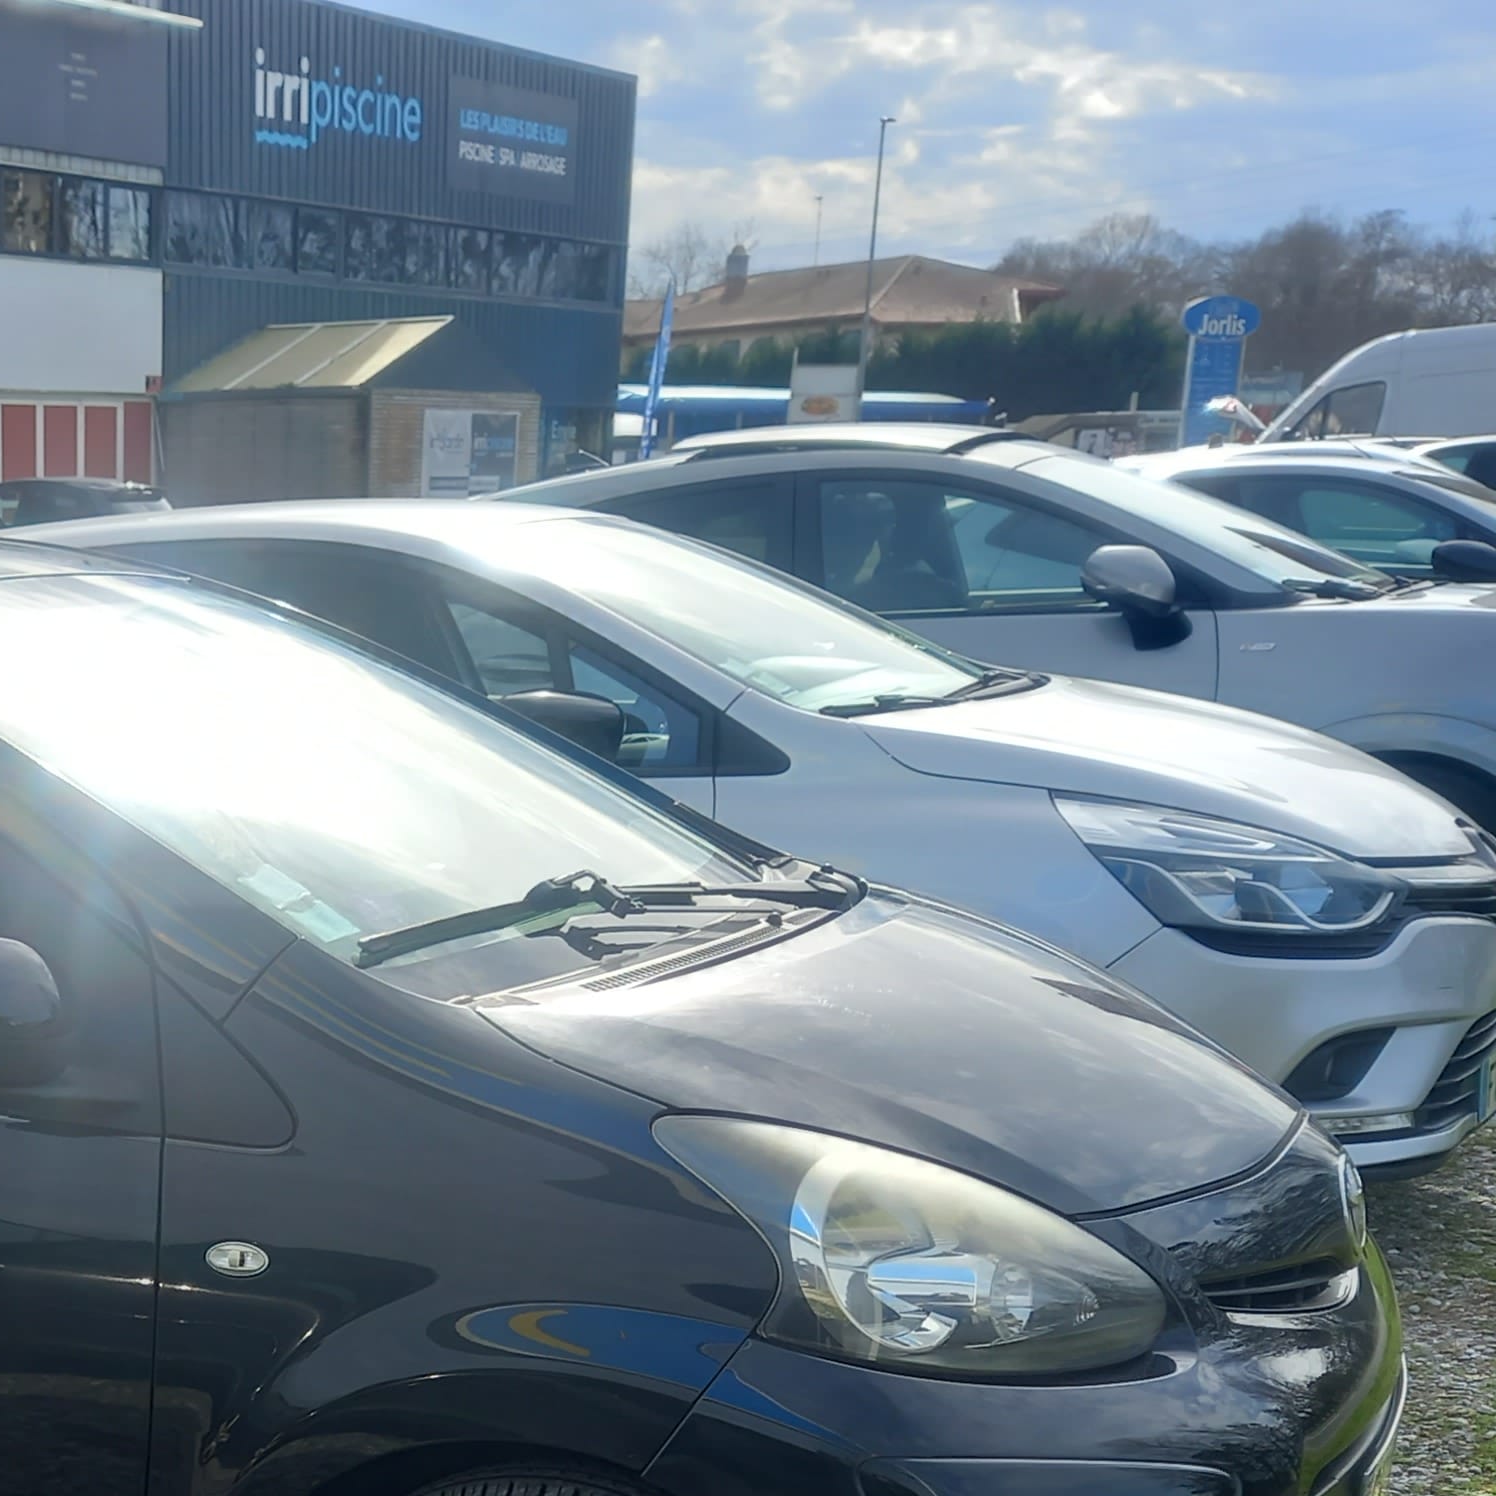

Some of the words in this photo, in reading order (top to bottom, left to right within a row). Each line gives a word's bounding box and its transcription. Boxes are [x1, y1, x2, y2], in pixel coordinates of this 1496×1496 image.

[460, 108, 480, 131] LES
[480, 111, 524, 139] PLAISIRS
[525, 120, 539, 141] DE
[459, 140, 495, 164] PISCINE
[499, 147, 516, 166] SPA
[520, 152, 566, 176] ARROSAGE
[1198, 313, 1246, 336] Jorlis
